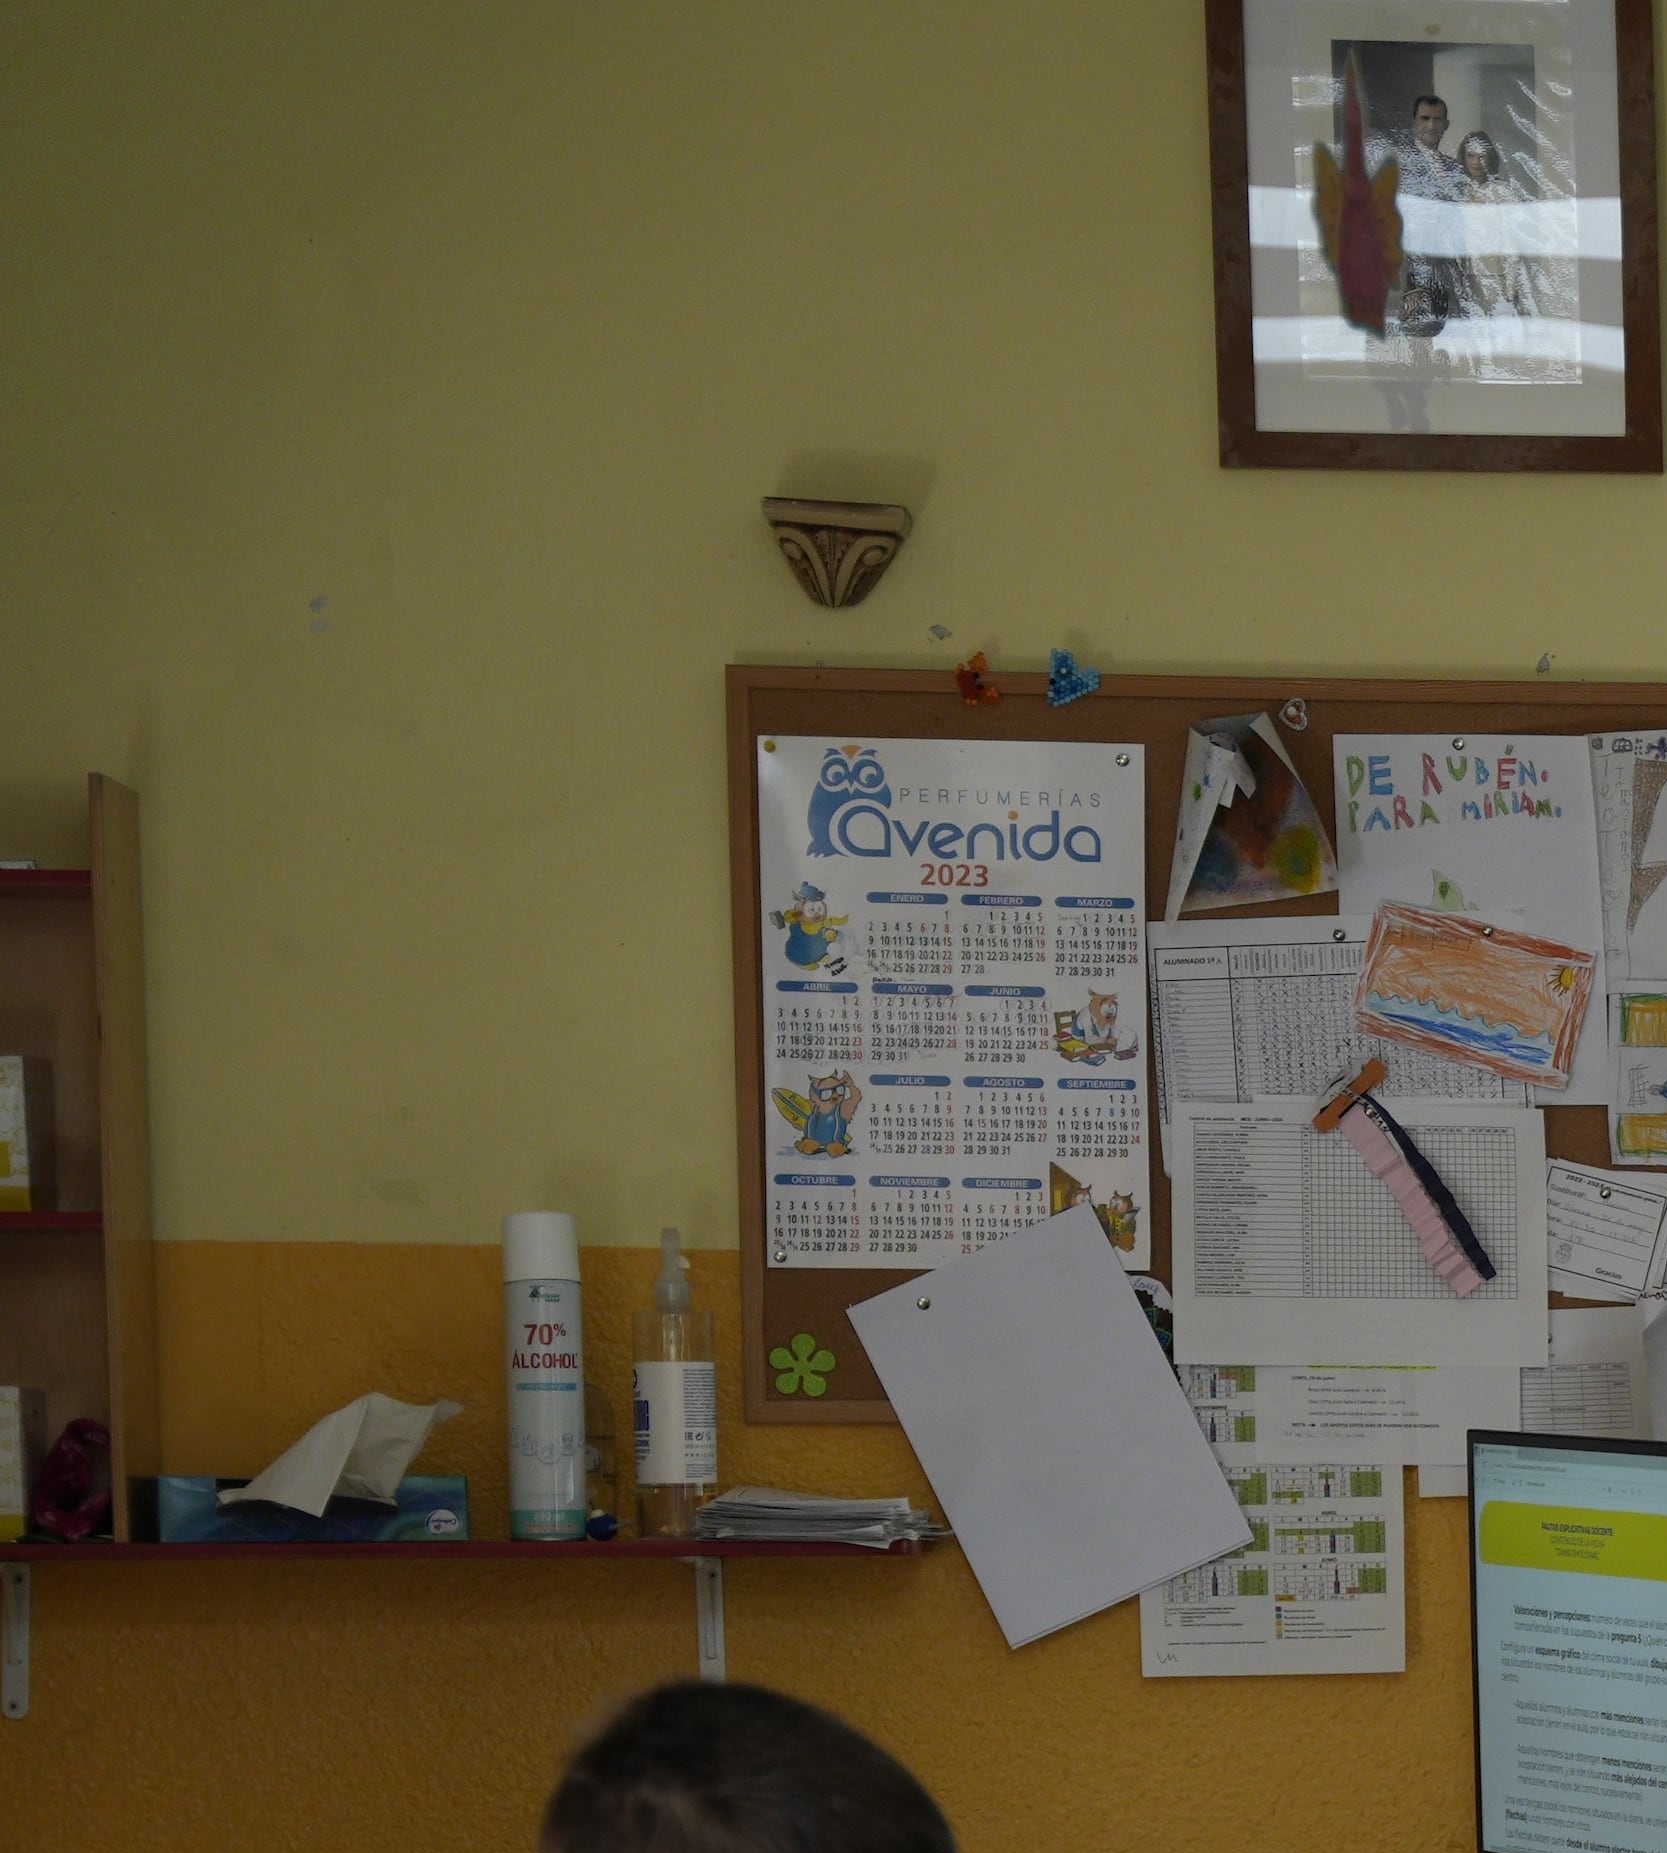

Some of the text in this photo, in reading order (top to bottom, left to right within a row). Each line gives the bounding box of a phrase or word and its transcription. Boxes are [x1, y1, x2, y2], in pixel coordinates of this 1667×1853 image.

[1345, 755, 1393, 797] DE
[899, 788, 1102, 808] PERFUMERÍAS
[1346, 795, 1441, 833] PARA
[920, 863, 989, 887] 2023
[890, 893, 924, 904] ENERO
[979, 895, 1023, 906] FEBRERO
[1077, 898, 1113, 908] MARZO
[802, 982, 831, 993] ABRIL
[897, 984, 927, 995] MAYO
[990, 986, 1021, 997] JUNIO
[895, 1076, 925, 1086] JULIO
[982, 1077, 1025, 1088] AGOSTO
[1066, 1078, 1128, 1090] SEPTIEMBRE
[791, 1174, 839, 1186] OCTUBRE
[879, 1176, 940, 1187] NOVIEMBRE
[975, 1178, 1030, 1189] DICIEMBRE
[523, 1323, 566, 1345] 70%
